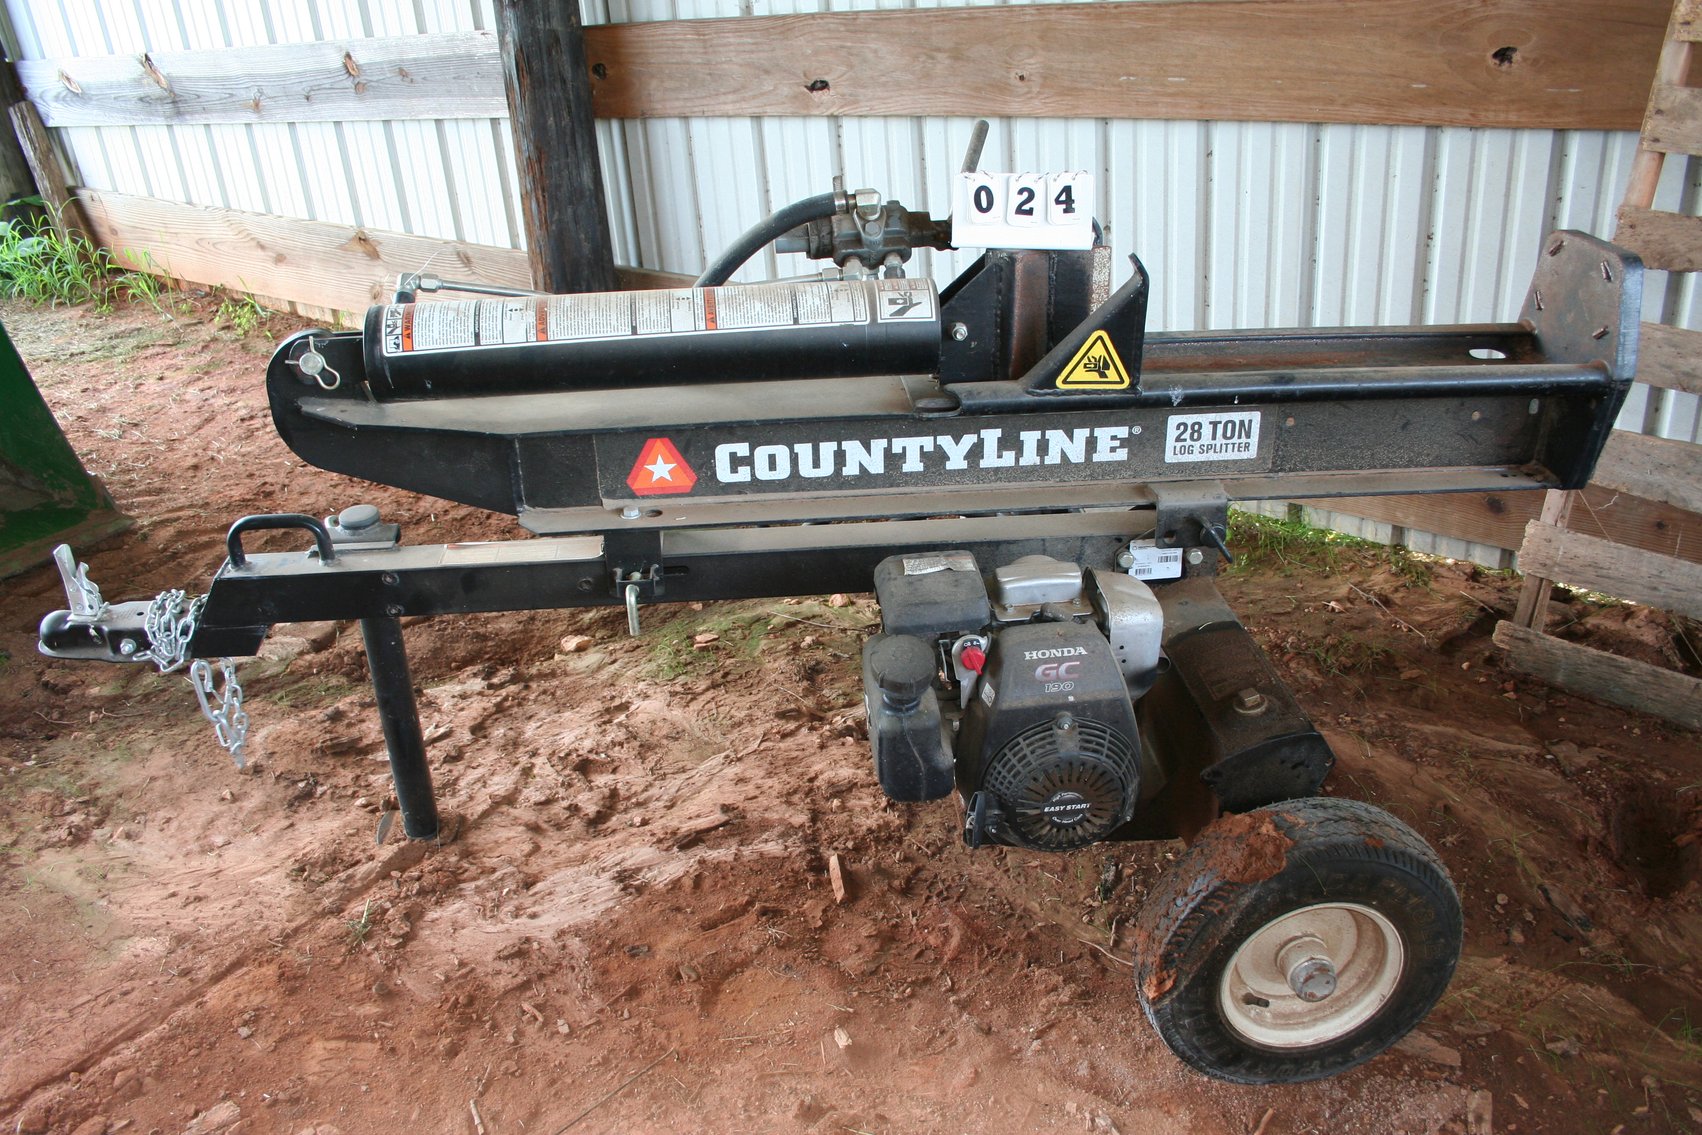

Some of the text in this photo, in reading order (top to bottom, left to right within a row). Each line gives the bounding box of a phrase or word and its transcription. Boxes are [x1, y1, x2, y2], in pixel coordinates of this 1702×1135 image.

[1174, 419, 1253, 443] 28 TON
[1173, 442, 1251, 456] LOG SPLITTER
[1024, 646, 1088, 660] HONDA
[1035, 661, 1080, 681] GC
[1045, 681, 1075, 693] 190
[1066, 803, 1092, 811] START
